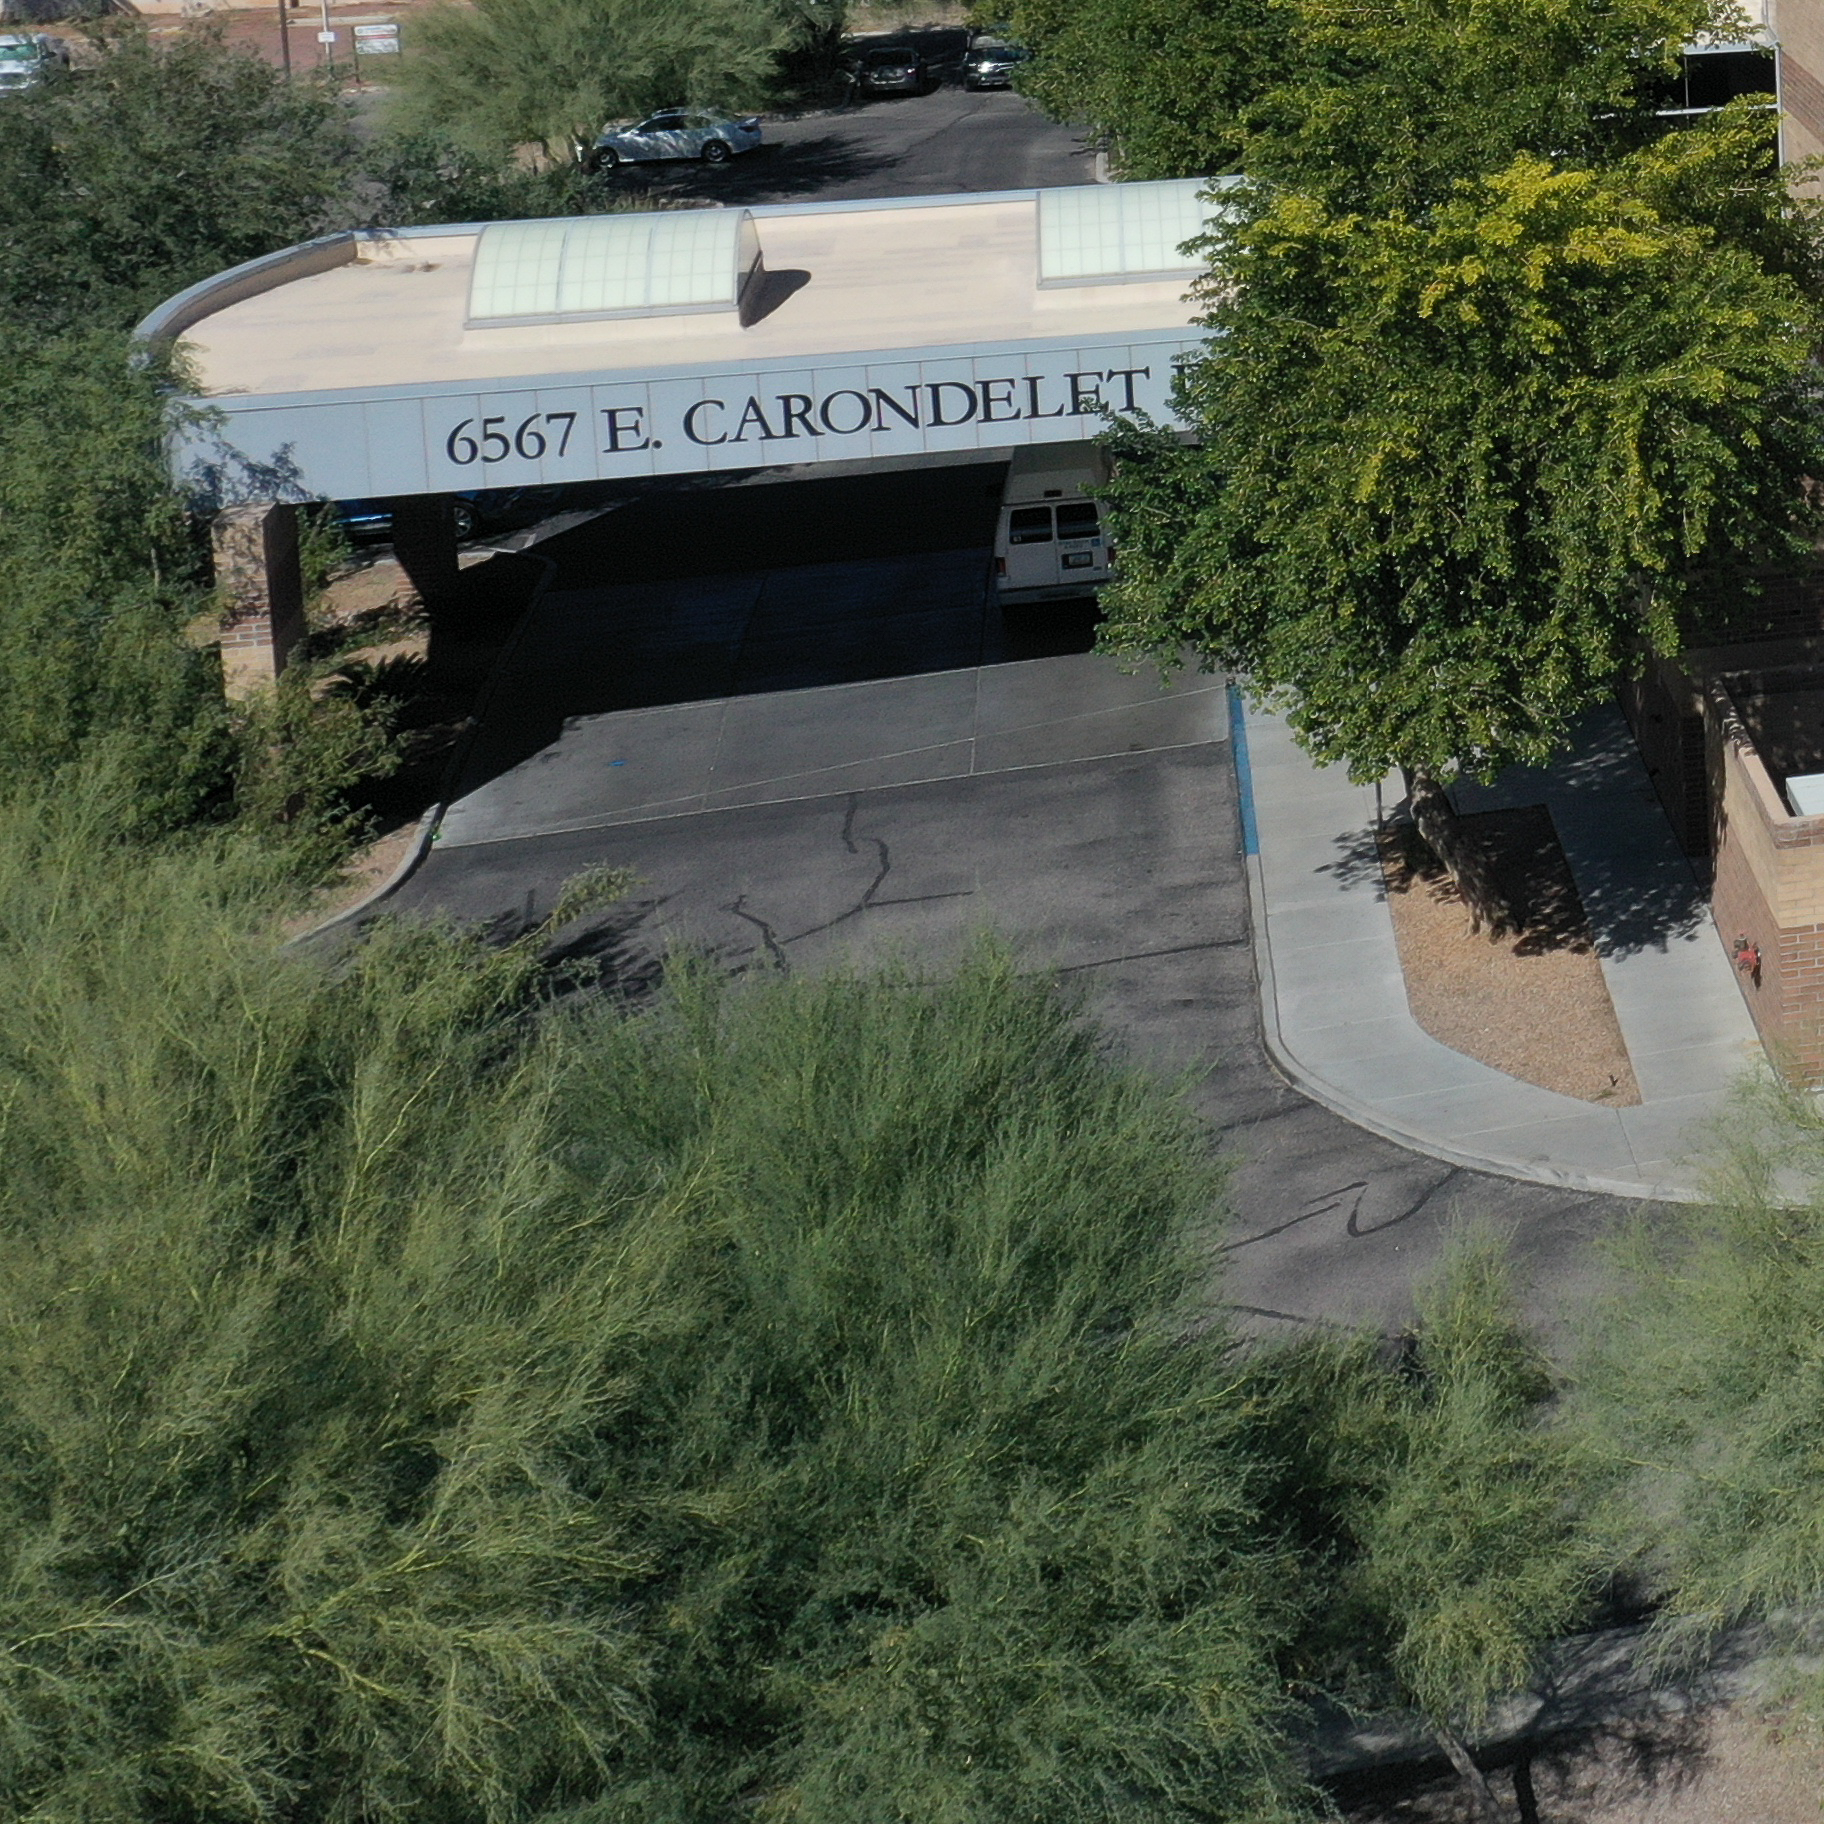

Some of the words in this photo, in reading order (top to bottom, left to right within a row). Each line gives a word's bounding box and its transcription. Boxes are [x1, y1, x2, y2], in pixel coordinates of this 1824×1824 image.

[446, 411, 577, 465] 6567
[601, 405, 663, 454] E.
[683, 366, 1150, 447] CARONDELET
